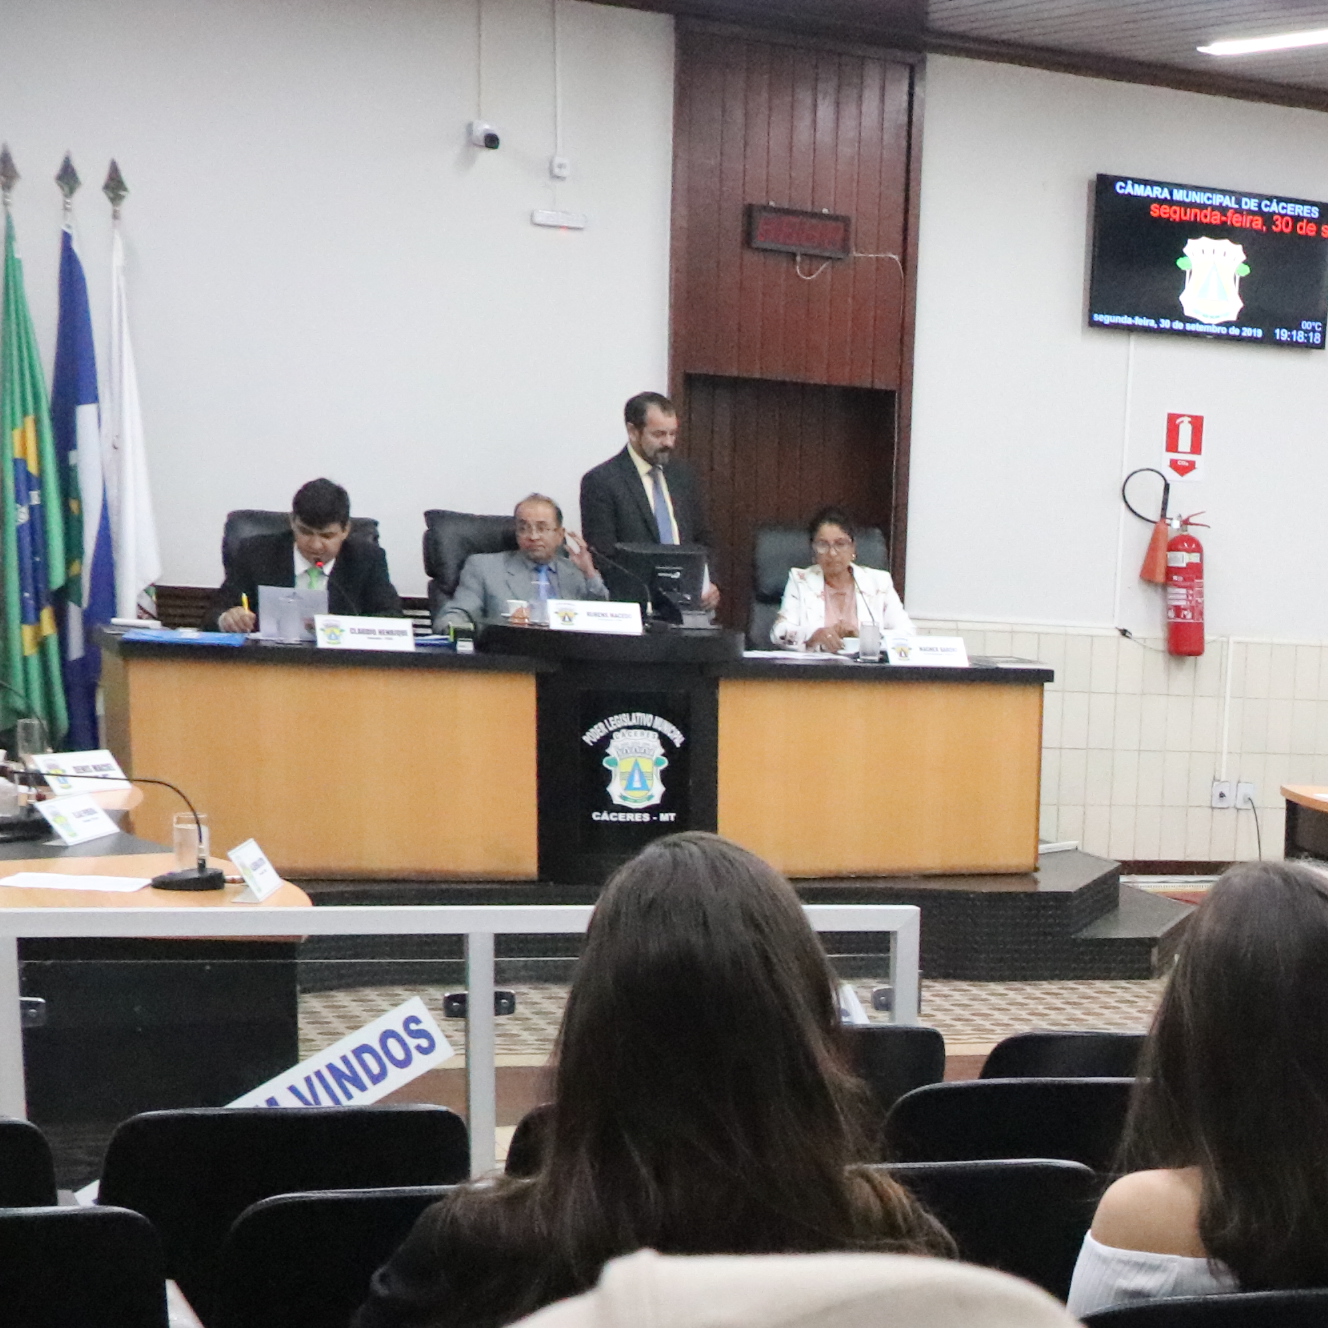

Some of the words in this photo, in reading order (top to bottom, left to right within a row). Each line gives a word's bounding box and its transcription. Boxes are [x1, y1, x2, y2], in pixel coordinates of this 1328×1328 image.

[1115, 180, 1171, 200] CÂMARA
[1172, 188, 1240, 208] MUNICIPAL
[1241, 197, 1259, 210] DE
[1261, 199, 1319, 218] CÁCERES
[1150, 203, 1267, 232] segunda-feira,
[1272, 214, 1292, 233] 30
[1297, 218, 1317, 237] de
[1093, 313, 1157, 329] segunda-feira,
[1159, 318, 1170, 329] 30
[1172, 320, 1184, 330] de
[1185, 322, 1227, 335] setembro
[1229, 326, 1240, 335] de
[1241, 327, 1263, 338] 2019
[1274, 328, 1321, 344] 19:18:18
[582, 721, 610, 747] PODER
[604, 712, 653, 731] LEGISLATIVO
[652, 715, 686, 748] MUNICIPAL
[592, 811, 651, 822] CÁCERES
[659, 813, 677, 822] MT
[287, 1014, 436, 1107] VINDOS
